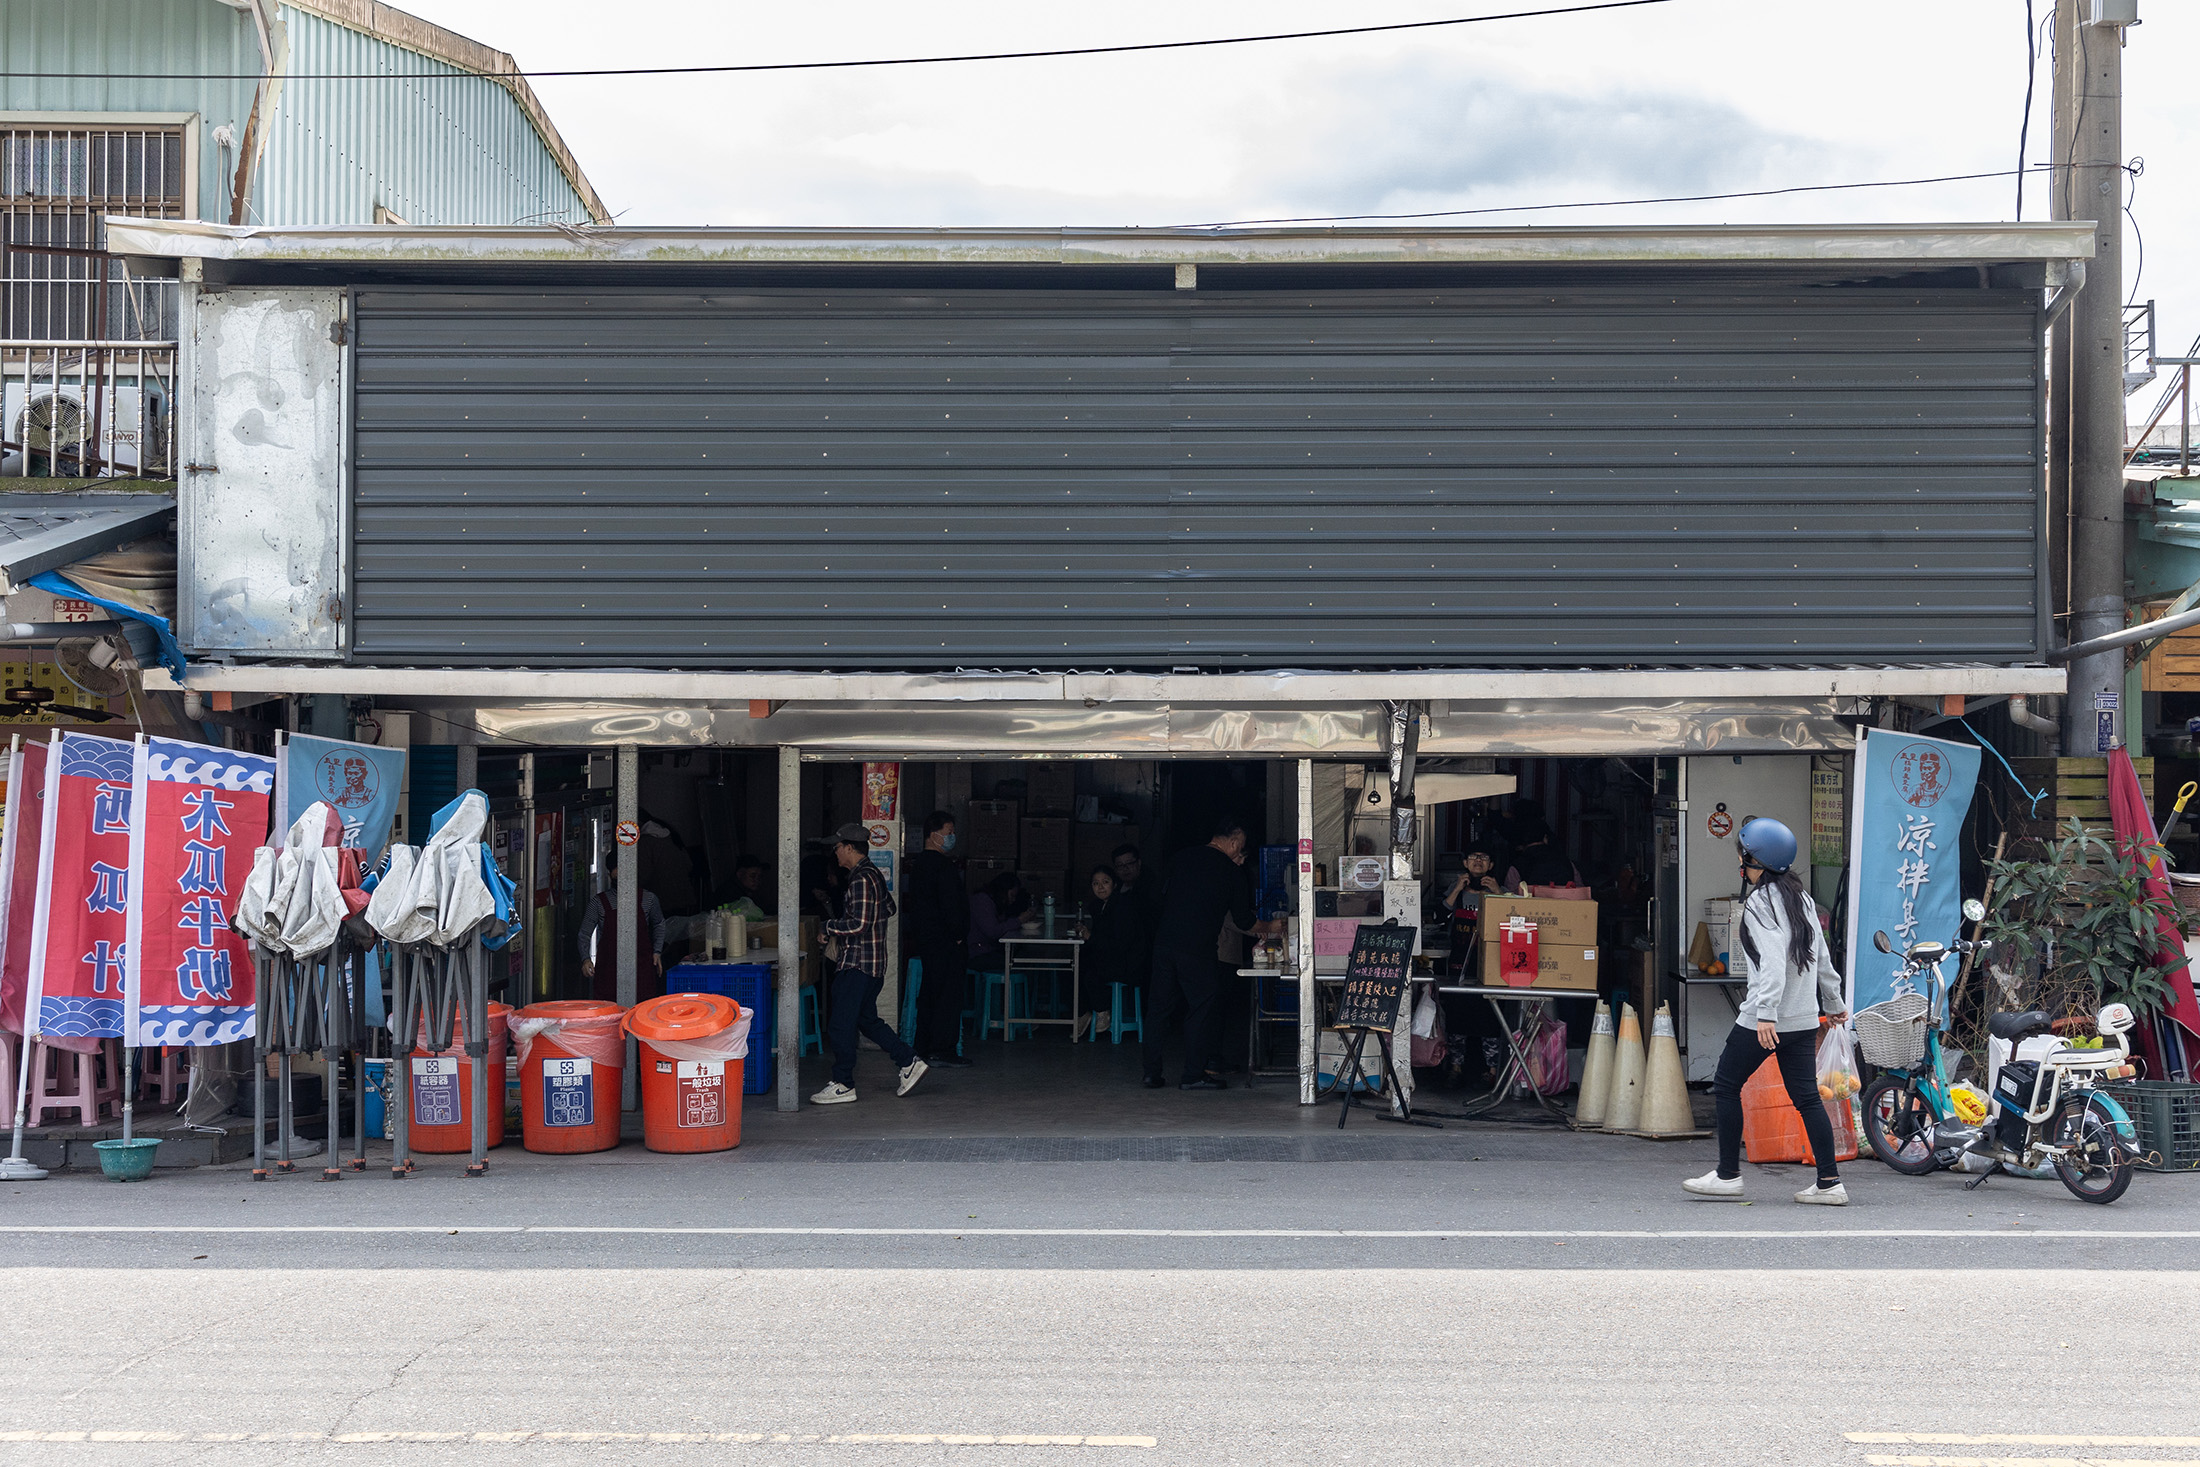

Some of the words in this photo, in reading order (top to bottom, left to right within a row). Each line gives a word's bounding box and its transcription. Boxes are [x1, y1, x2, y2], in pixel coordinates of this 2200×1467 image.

[105, 433, 135, 441] SNYO
[420, 1075, 448, 1086] 紙容器
[552, 1076, 583, 1087] 塑膠類
[682, 1076, 721, 1088] 一般垃圾
